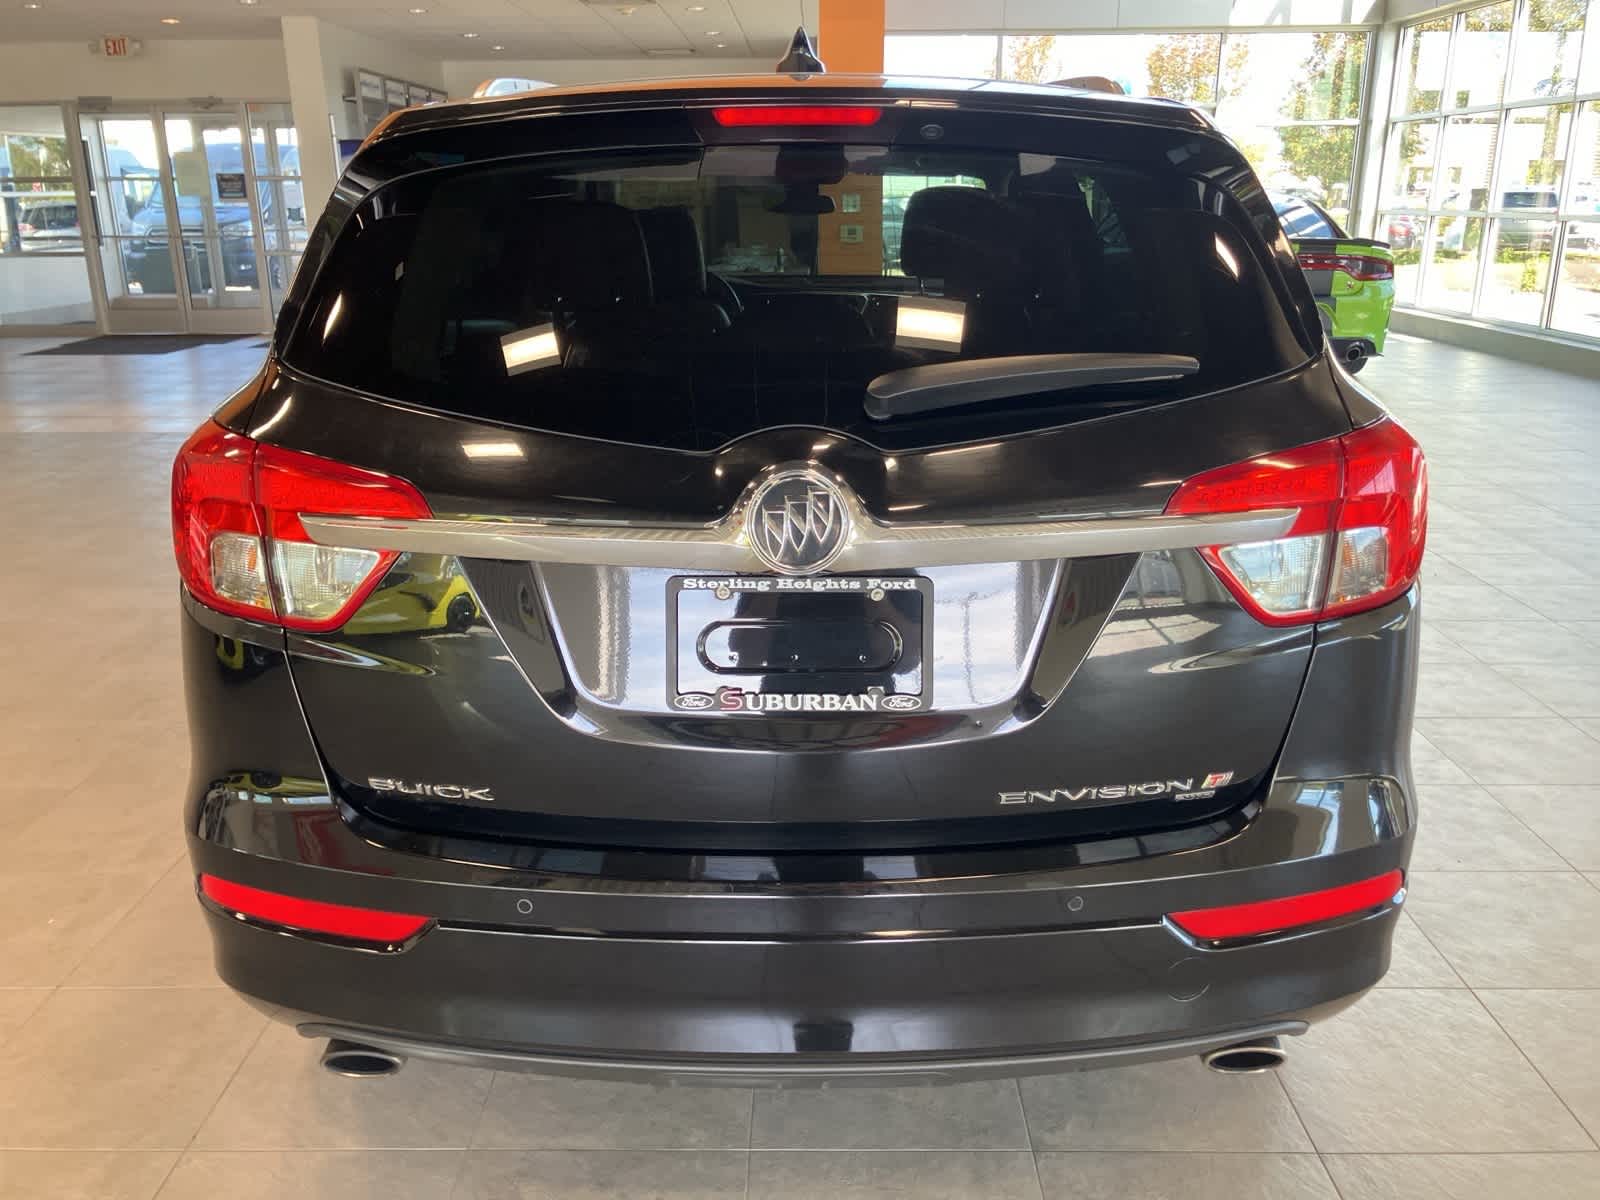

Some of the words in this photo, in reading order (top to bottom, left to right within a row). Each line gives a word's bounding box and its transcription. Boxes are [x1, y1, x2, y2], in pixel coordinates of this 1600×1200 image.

[104, 38, 127, 57] EXIT
[683, 578, 771, 591] Sterling
[776, 578, 860, 591] Heights
[866, 578, 917, 589] Ford
[720, 688, 877, 711] SUBURBAN
[368, 777, 495, 801] BUICK
[998, 778, 1193, 804] ENVISION
